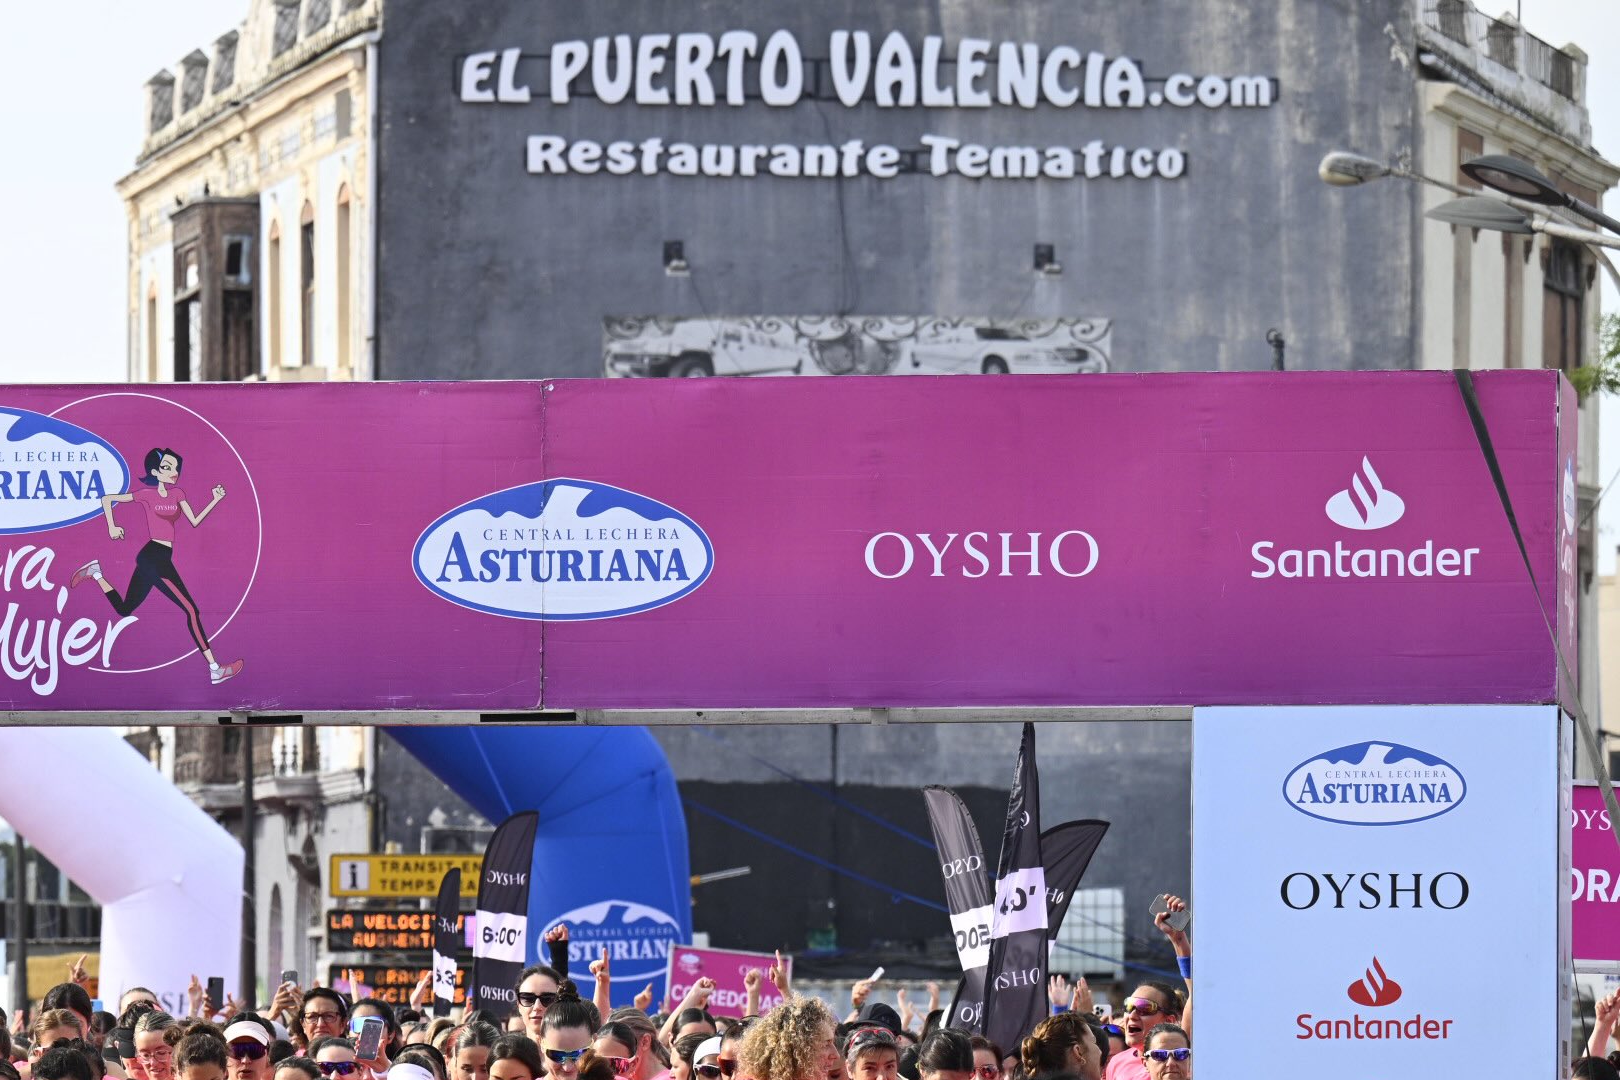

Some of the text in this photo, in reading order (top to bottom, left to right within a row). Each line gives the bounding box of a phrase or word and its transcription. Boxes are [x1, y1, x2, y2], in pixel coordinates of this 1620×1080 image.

[461, 29, 1271, 108] EL PUERTO VALENCIA.com
[526, 134, 1184, 179] Restaurante Tematico
[14, 451, 100, 462] LECHERA
[155, 504, 178, 512] OYSHO
[483, 527, 680, 540] CENTRAL LECHERA
[436, 531, 690, 583] ASTURIANA
[864, 530, 1099, 579] OYSHO
[1251, 540, 1479, 578] Santander
[1296, 773, 1454, 804] ASTURIANA
[1325, 770, 1447, 779] CENTRAL LECHERA
[380, 879, 436, 892] TEMPS
[1280, 872, 1469, 910] OYSHO
[331, 914, 354, 930] LA
[1296, 1014, 1453, 1040] Santander
